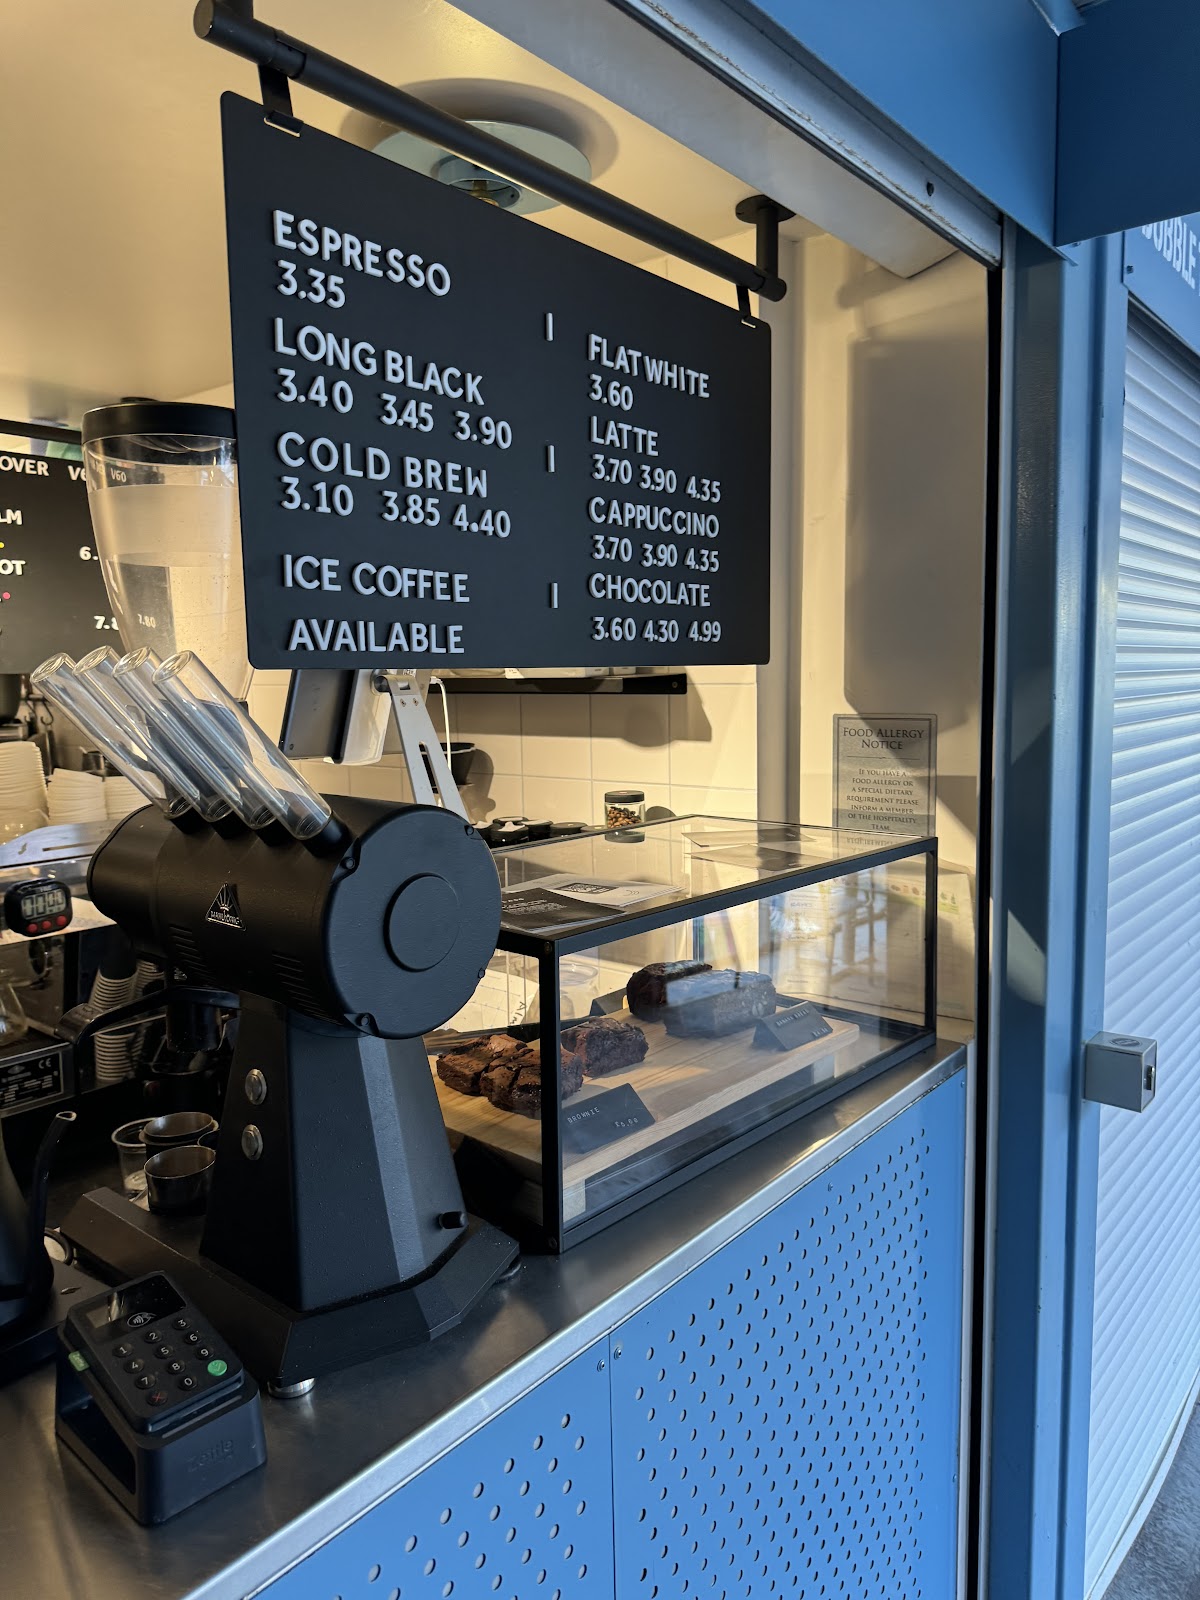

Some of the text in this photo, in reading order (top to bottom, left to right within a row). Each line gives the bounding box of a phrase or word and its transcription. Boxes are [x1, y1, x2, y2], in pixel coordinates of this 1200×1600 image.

[273, 209, 451, 297] ESPRESSO
[277, 259, 346, 309] 3.35
[275, 317, 485, 406] LONG BLACK
[589, 333, 710, 398] FLAT WHITE
[277, 367, 513, 450] 3.40 3.45 3.90
[589, 373, 634, 411] 3.60
[591, 415, 659, 457] LATTE
[68, 465, 87, 481] V6
[278, 431, 488, 499] COLD BREW
[592, 453, 721, 503] 3.70 3.90 4.35
[281, 475, 511, 538] 3.10 3.85 4.40
[590, 496, 720, 538] CAPPUCCINO
[0, 559, 26, 576] OT
[593, 534, 720, 573] 3.70 3.90 4.35
[284, 553, 470, 603] ICE COFFEE
[590, 572, 711, 607] CHOCOLATE
[289, 618, 465, 654] AVAILABLE
[592, 616, 722, 644] 3.60 4.30 4.99
[843, 727, 925, 739] FOOD ALLERGY
[861, 739, 904, 750] NOTICE
[852, 777, 871, 785] FOOD
[885, 788, 914, 796] DIETARY
[846, 795, 919, 806] REQUIREMENT PLEASE
[851, 804, 878, 812] INFORM
[885, 807, 914, 815] MEMBER
[871, 823, 890, 831] TEAM
[873, 814, 916, 824] HOSPITALITY
[566, 1106, 600, 1124] BROWNIE
[119, 1346, 127, 1354] 1
[149, 1332, 158, 1340] 2
[132, 1333, 198, 1369] 4 5 6
[141, 1348, 209, 1385] 7 8 9
